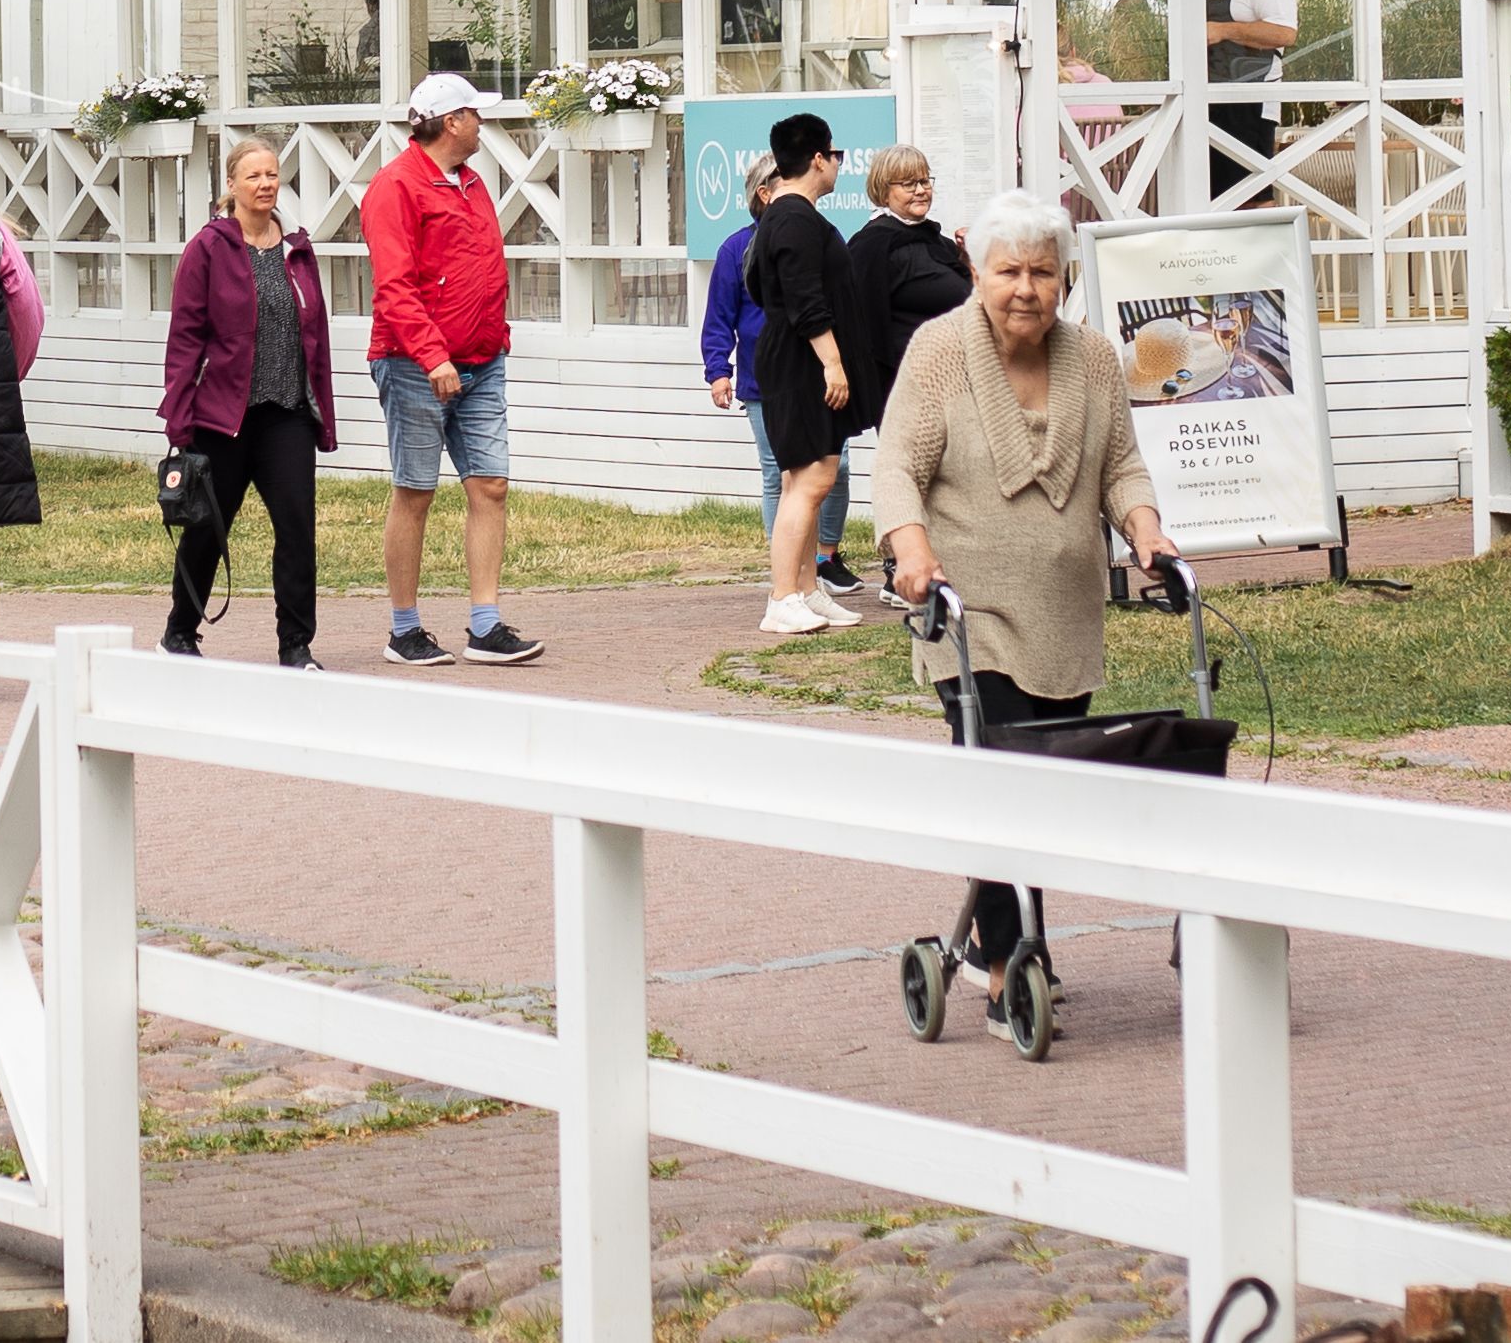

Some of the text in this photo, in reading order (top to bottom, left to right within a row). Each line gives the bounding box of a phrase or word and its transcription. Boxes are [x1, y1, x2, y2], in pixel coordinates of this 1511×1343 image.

[1159, 255, 1238, 270] KAIVOHUONE
[1179, 419, 1247, 435] RAIKAS
[1169, 434, 1261, 452] ROSEVIINI
[1180, 459, 1196, 469] 36
[1202, 457, 1210, 467] €
[1225, 454, 1254, 465] PLO
[1218, 478, 1239, 487] CLUB
